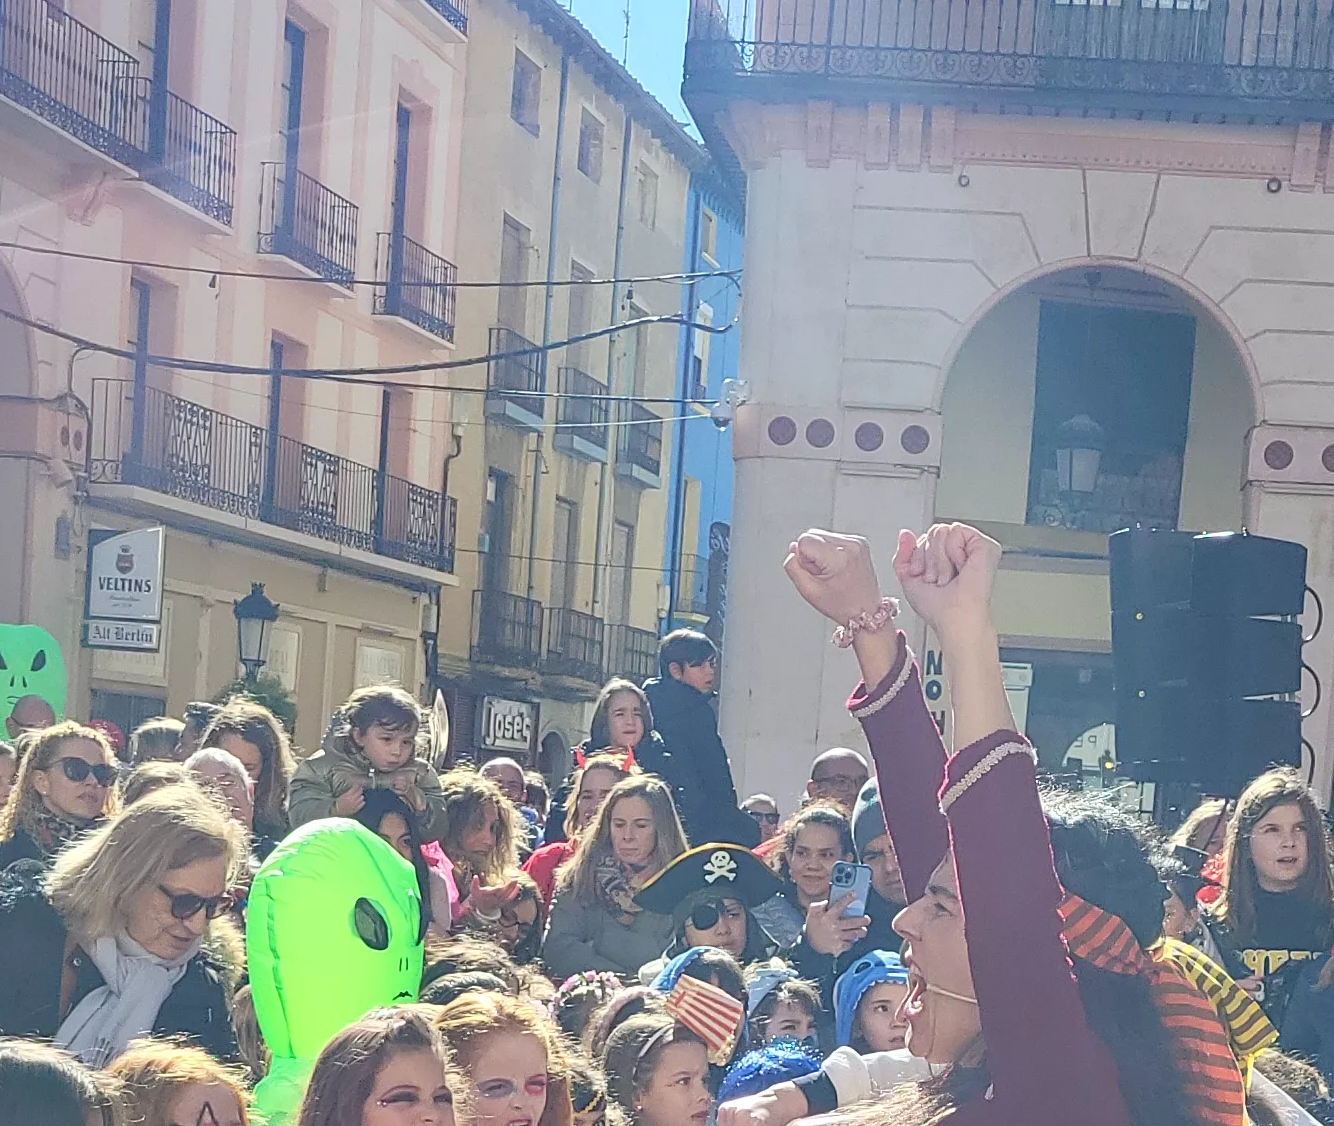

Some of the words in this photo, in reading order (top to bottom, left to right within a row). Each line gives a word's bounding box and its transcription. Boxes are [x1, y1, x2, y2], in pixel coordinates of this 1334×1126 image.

[98, 576, 152, 594] VELTINS
[93, 625, 111, 641] Alt
[114, 626, 153, 643] Berlin
